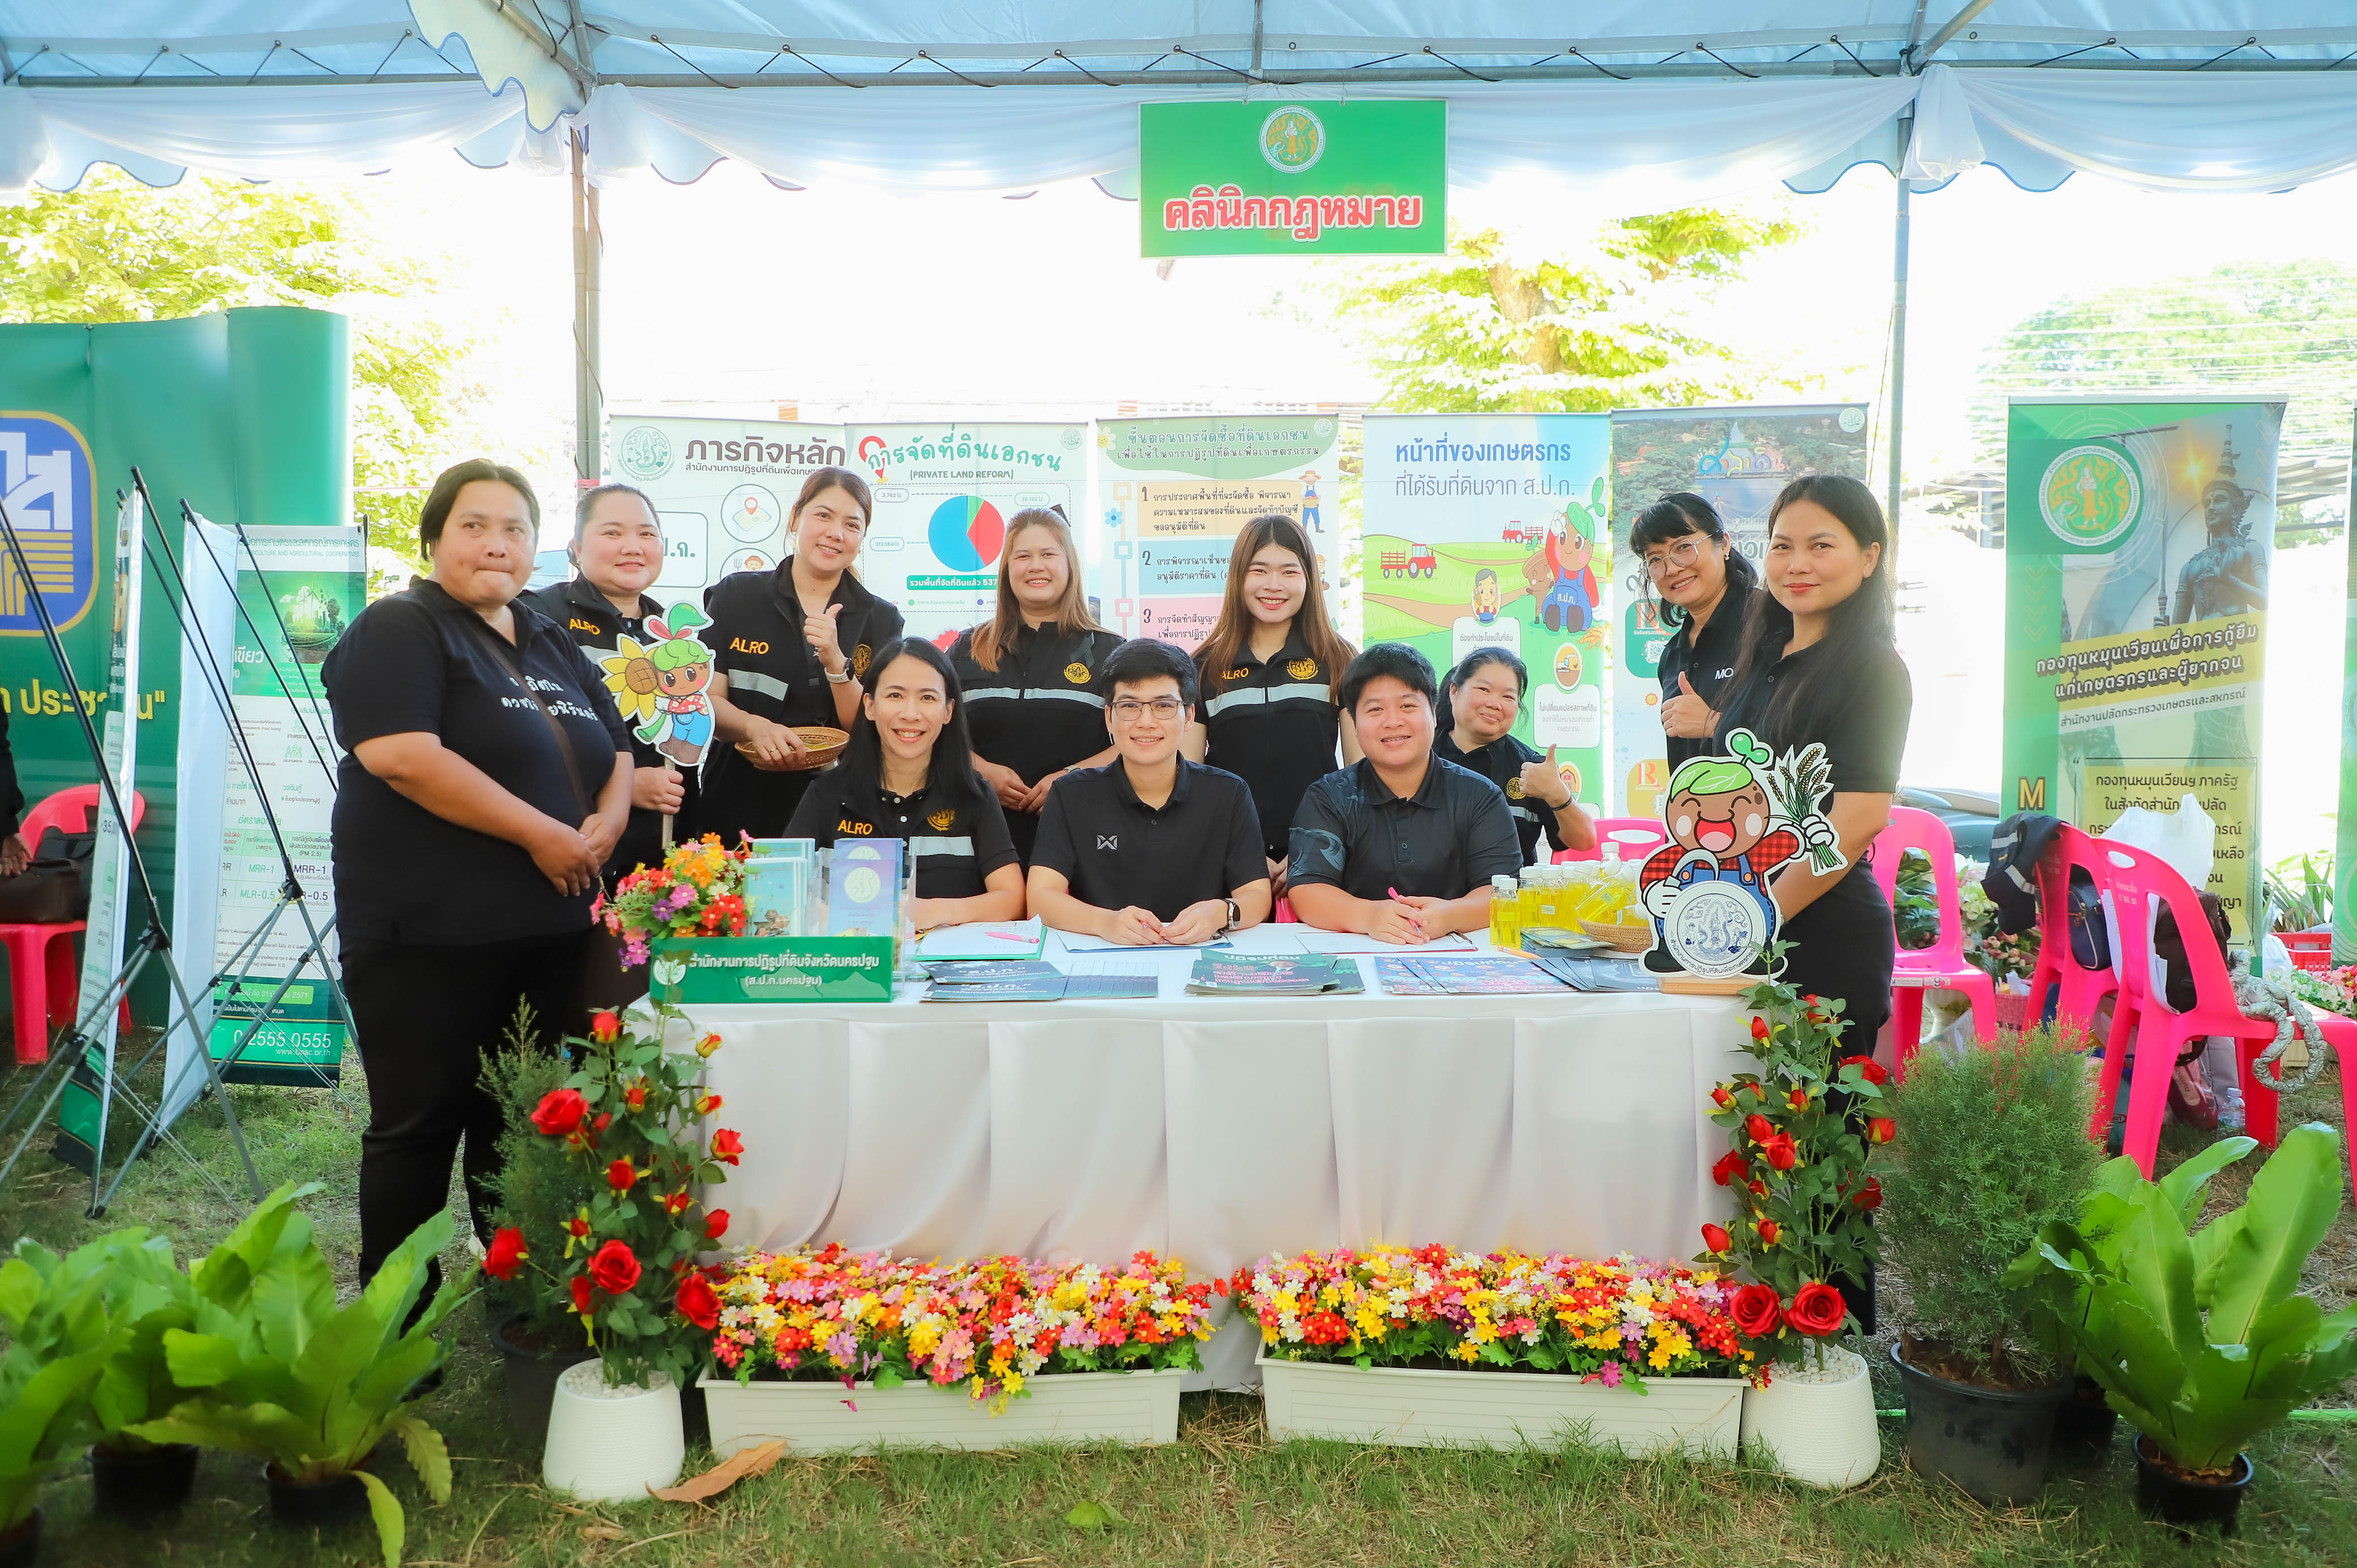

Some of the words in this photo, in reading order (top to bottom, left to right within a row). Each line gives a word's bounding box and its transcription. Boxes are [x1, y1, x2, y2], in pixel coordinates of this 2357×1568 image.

[1164, 185, 1423, 241] คลินิกกฎหมาย
[1128, 422, 1311, 444] ขั้นตอนการจัดซื้อที่ดินเอกชน
[686, 436, 845, 466] ภารกิจหลัก
[867, 423, 1062, 472] การจัดที่ดินเอกชน
[1117, 443, 1320, 462] เพื่อใช้ในการปฏิรูปที่ดินเพื่อเกษตรกรรม
[1396, 432, 1572, 462] หน้าที่ของเกษตรกร
[684, 462, 816, 476] สำนักงานการปฏิรูปที่ดินเพื่อเกษต
[910, 470, 948, 480] (PRIVATE
[950, 470, 974, 479] LAND
[976, 470, 1014, 480] REFORM)
[1395, 469, 1517, 496] ที่ได้รับที่ดินจาก
[1524, 474, 1576, 496] ส.ป.ก.
[1141, 487, 1149, 502] 1
[1258, 489, 1291, 500] พิจารณา
[1142, 550, 1151, 566] 2
[1156, 553, 1231, 566] การพิจารณาเห็นชอ
[909, 577, 981, 587] รวมพื้นที่จัดที่ดินแล้ว
[1557, 591, 1576, 604] ส.ป.ก.
[1143, 608, 1152, 624] 3
[1158, 611, 1219, 625] การจัดทำสัญญา
[569, 617, 601, 636] ALRO
[729, 637, 769, 655] ALRO
[2035, 621, 2258, 675] กองทุนหมุนเวียนเพื่อการกู้ยืม
[1220, 667, 1249, 680] ALRO
[2054, 653, 2244, 699] แก่เกษตรกรและผู้ยากจน
[2060, 687, 2246, 728] สำนักงานปลัดกระทรวงเกษตรและสหกรณ์
[2096, 774, 2197, 791] กองทุนหมุนเวียนฯ
[2199, 774, 2239, 790] ภาครัฐ
[2018, 777, 2046, 811] M
[837, 819, 873, 835] ALRO
[248, 864, 275, 874] MRR-1
[293, 864, 326, 874] MRR-1
[240, 889, 275, 899] MLR-0.5
[1670, 939, 1755, 974] สำนักงานการปฏิรูปที่ดินเพื่อเกษตรกรร
[291, 1032, 332, 1048] 0555
